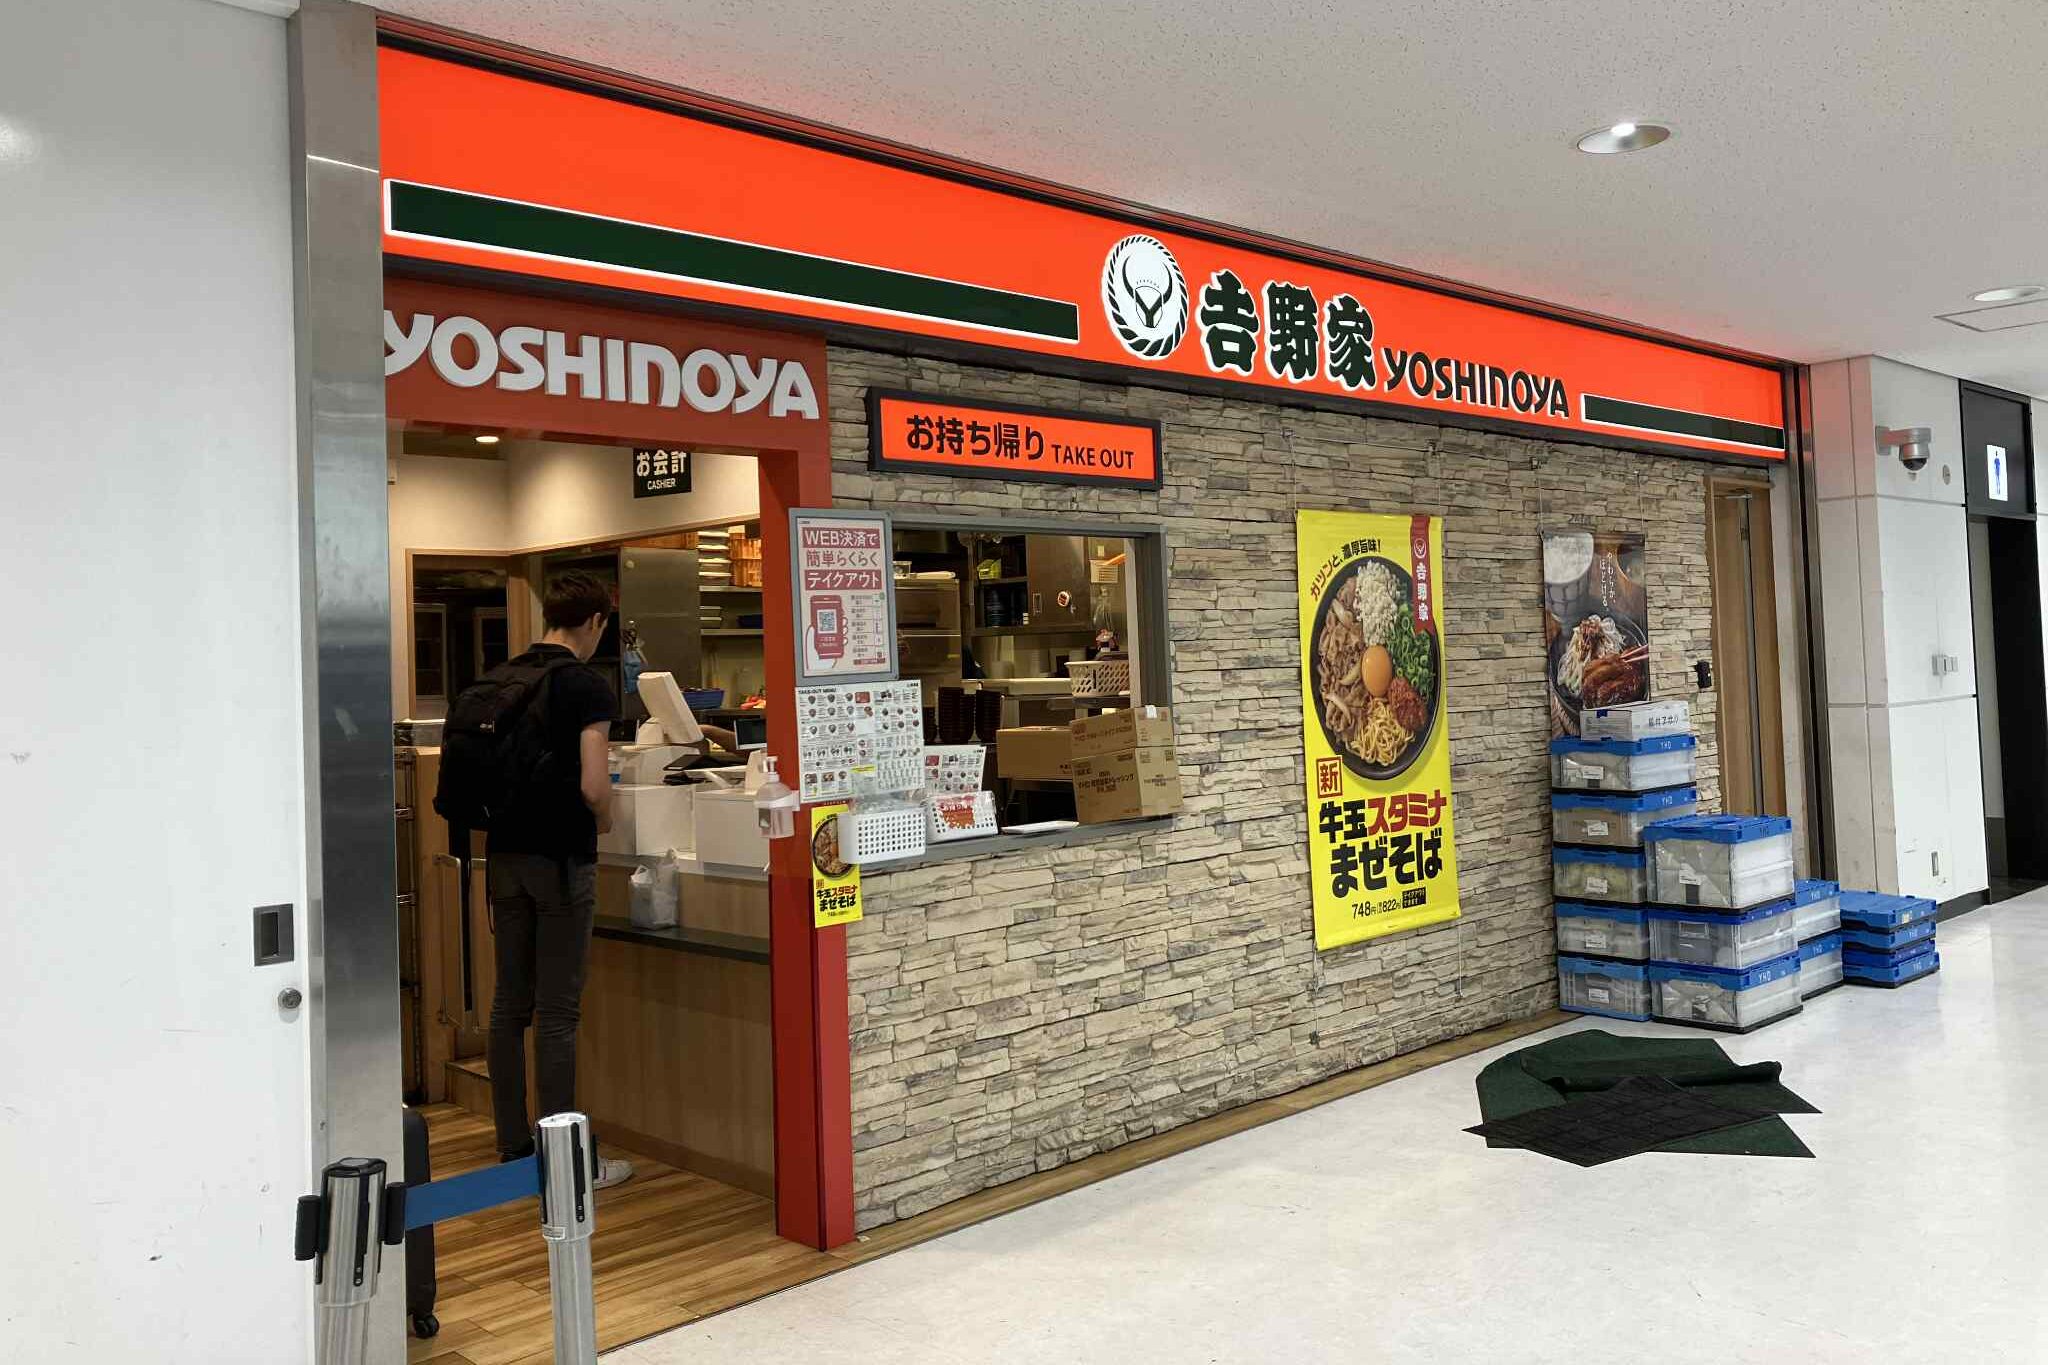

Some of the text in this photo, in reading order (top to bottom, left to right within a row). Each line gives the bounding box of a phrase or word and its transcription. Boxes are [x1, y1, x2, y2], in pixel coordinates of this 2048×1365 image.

[1197, 269, 1377, 391] 吉野家
[384, 309, 820, 420] YOSHINOYA
[1383, 346, 1569, 418] YOSHINOYA
[637, 449, 687, 477] お会計
[906, 414, 1134, 470] お持ち帰り TAKE OUT
[647, 478, 676, 490] CASHIER
[805, 529, 878, 547] WEB決済で
[806, 550, 879, 568] 簡単らくらく
[807, 571, 880, 589] テイクアウト
[1319, 762, 1338, 792] 新
[1319, 789, 1447, 843] 牛玉スタミナ
[1331, 828, 1443, 898] まぜそば
